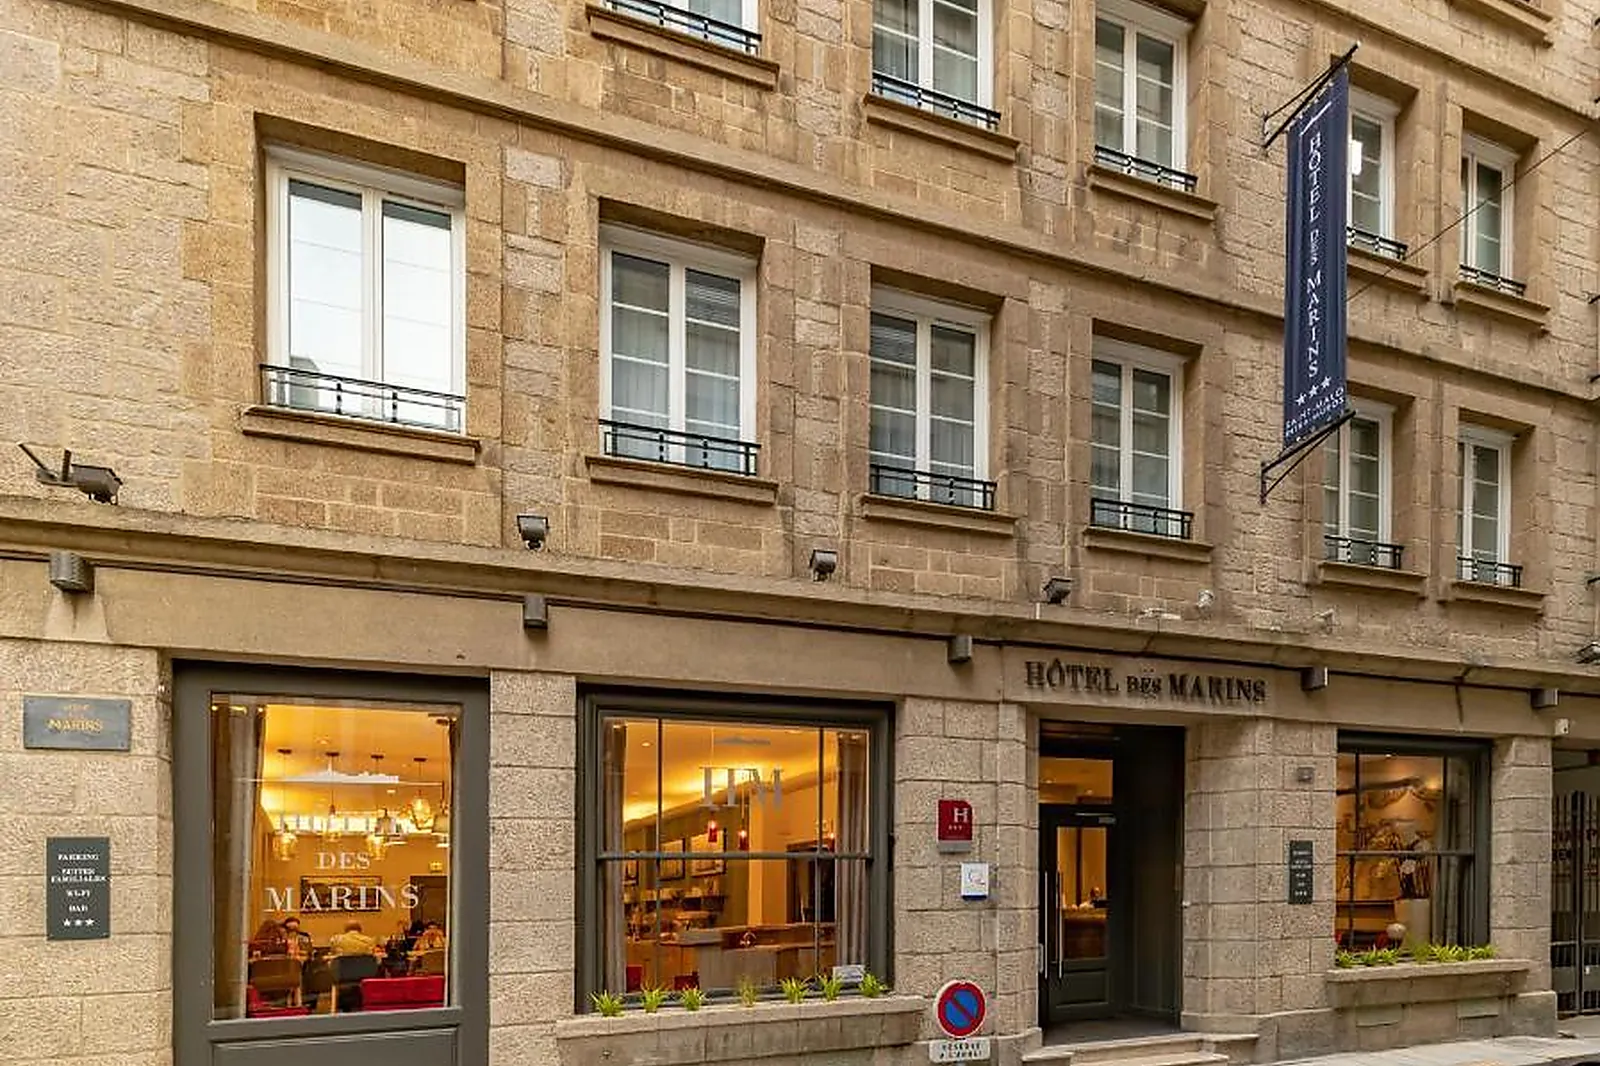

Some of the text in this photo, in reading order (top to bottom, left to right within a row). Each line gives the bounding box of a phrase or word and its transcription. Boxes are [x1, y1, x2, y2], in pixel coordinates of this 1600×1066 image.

[1309, 228, 1320, 267] DES
[1306, 269, 1321, 378] MARINS
[1168, 673, 1266, 702] MARINS
[953, 807, 969, 824] H
[315, 851, 371, 871] DES
[264, 882, 419, 913] MARINS
